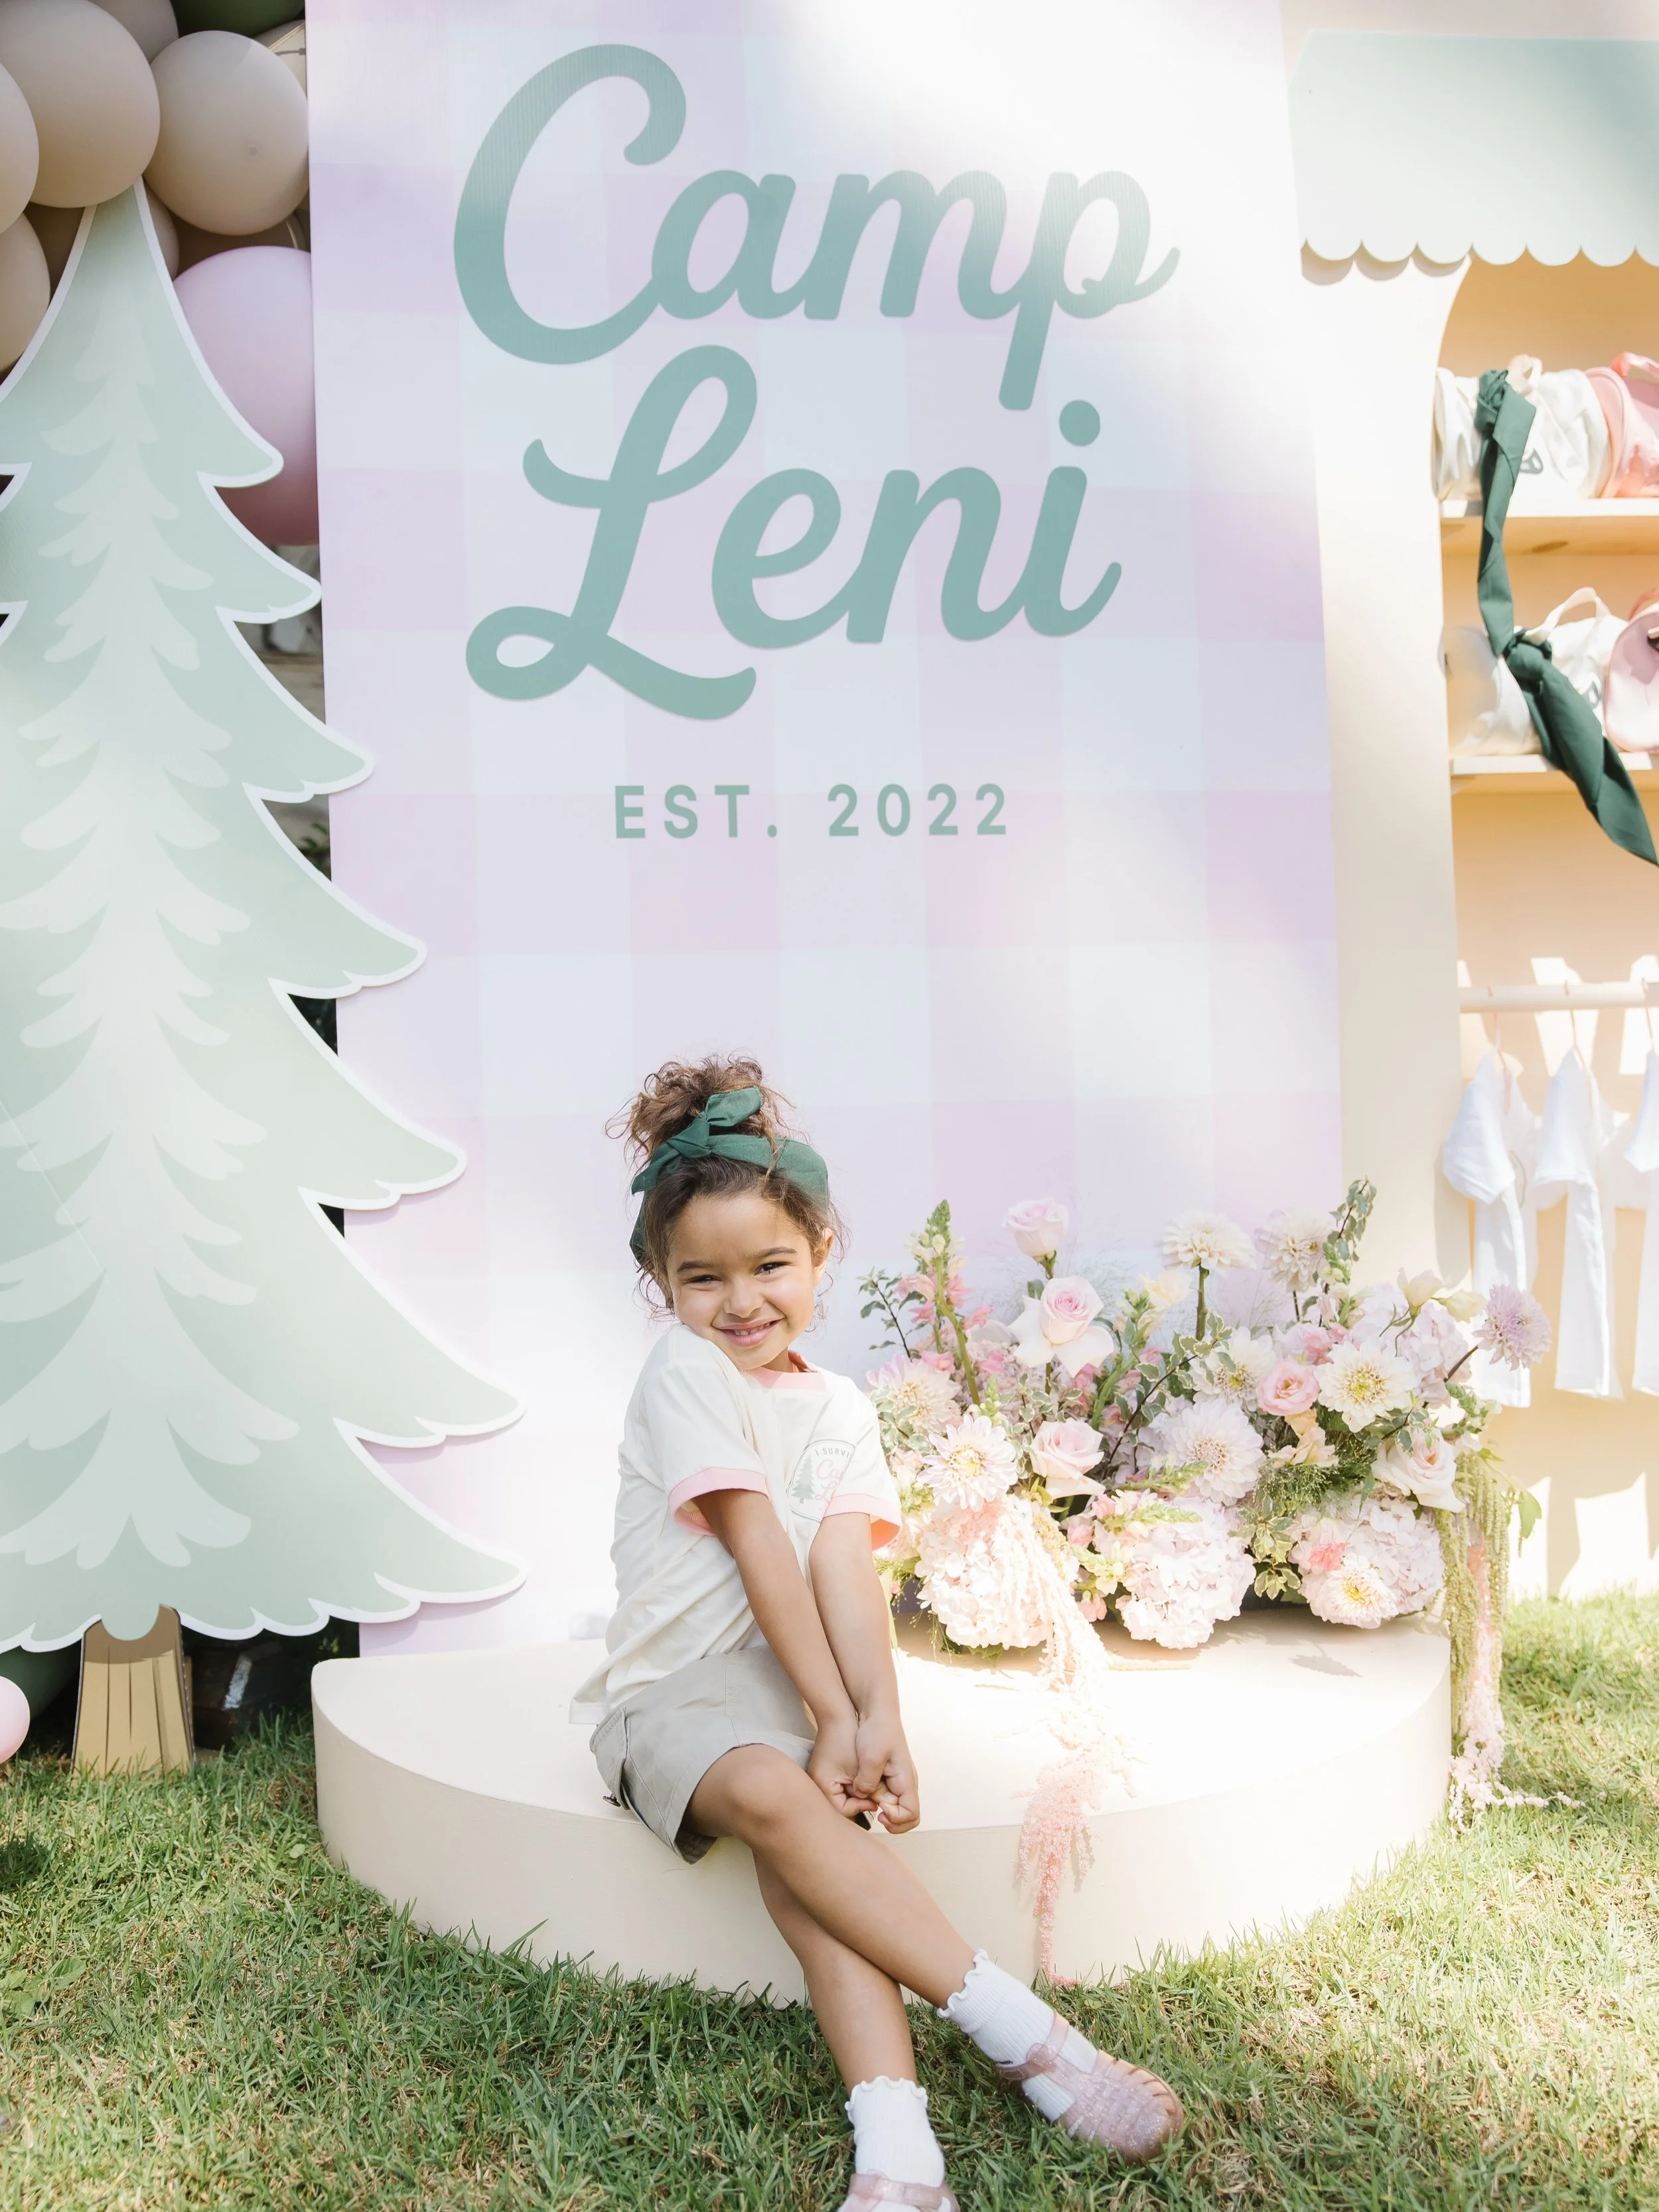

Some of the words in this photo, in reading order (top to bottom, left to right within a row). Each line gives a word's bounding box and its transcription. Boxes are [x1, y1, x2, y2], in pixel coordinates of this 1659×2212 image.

[453, 44, 1180, 410] Camp
[466, 345, 1121, 720] Leni
[614, 785, 778, 839] EST.
[828, 784, 1007, 836] 2022
[823, 1447, 851, 1460] SURVI
